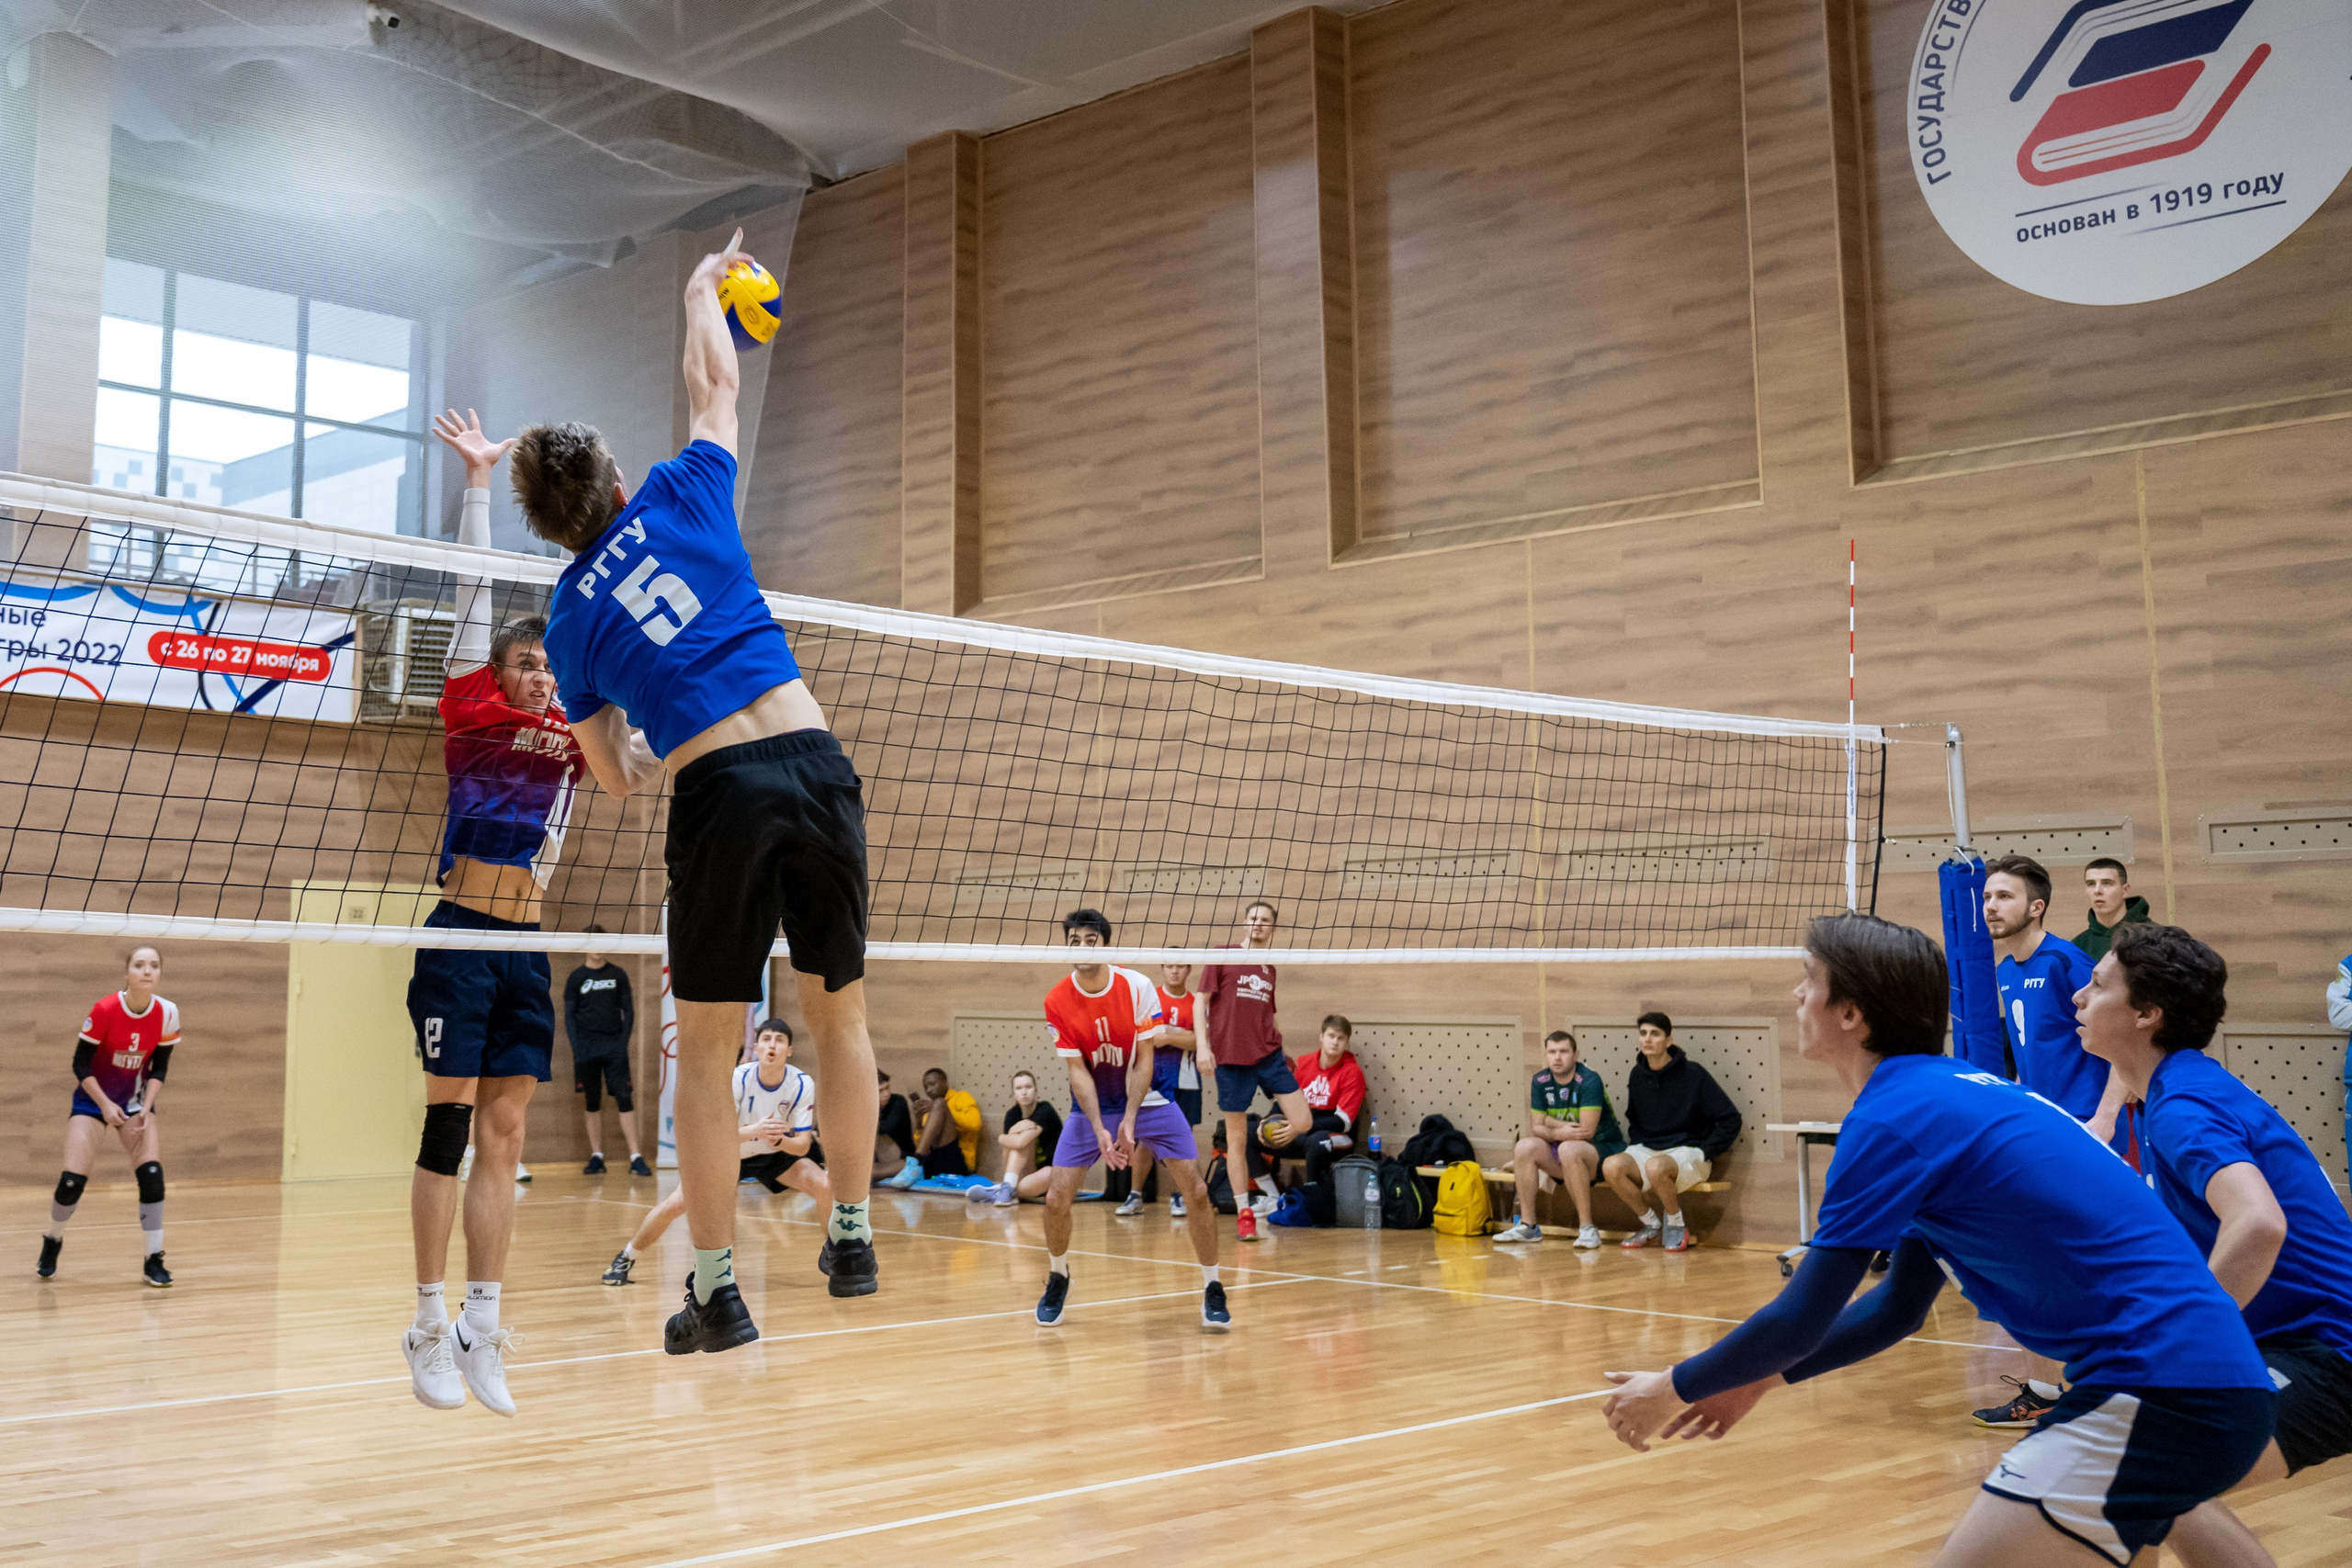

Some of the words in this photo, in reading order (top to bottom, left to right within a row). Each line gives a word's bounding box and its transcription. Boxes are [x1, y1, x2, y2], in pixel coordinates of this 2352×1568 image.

[2016, 209, 2116, 243] основан
[2126, 204, 2140, 220] в
[2149, 183, 2212, 213] 1919
[2222, 172, 2284, 199] году
[576, 517, 647, 600] РГГУ
[611, 555, 703, 647] 5
[57, 638, 121, 666] 2022
[160, 642, 174, 656] с
[175, 639, 199, 659] 26
[203, 647, 227, 661] по
[231, 646, 252, 664] 27
[255, 652, 320, 673] ноября
[1095, 1016, 1111, 1043] 11
[1170, 1006, 1179, 1026] 3
[129, 1032, 141, 1053] 3
[424, 1017, 444, 1058] 12
[749, 1095, 755, 1113] 1
